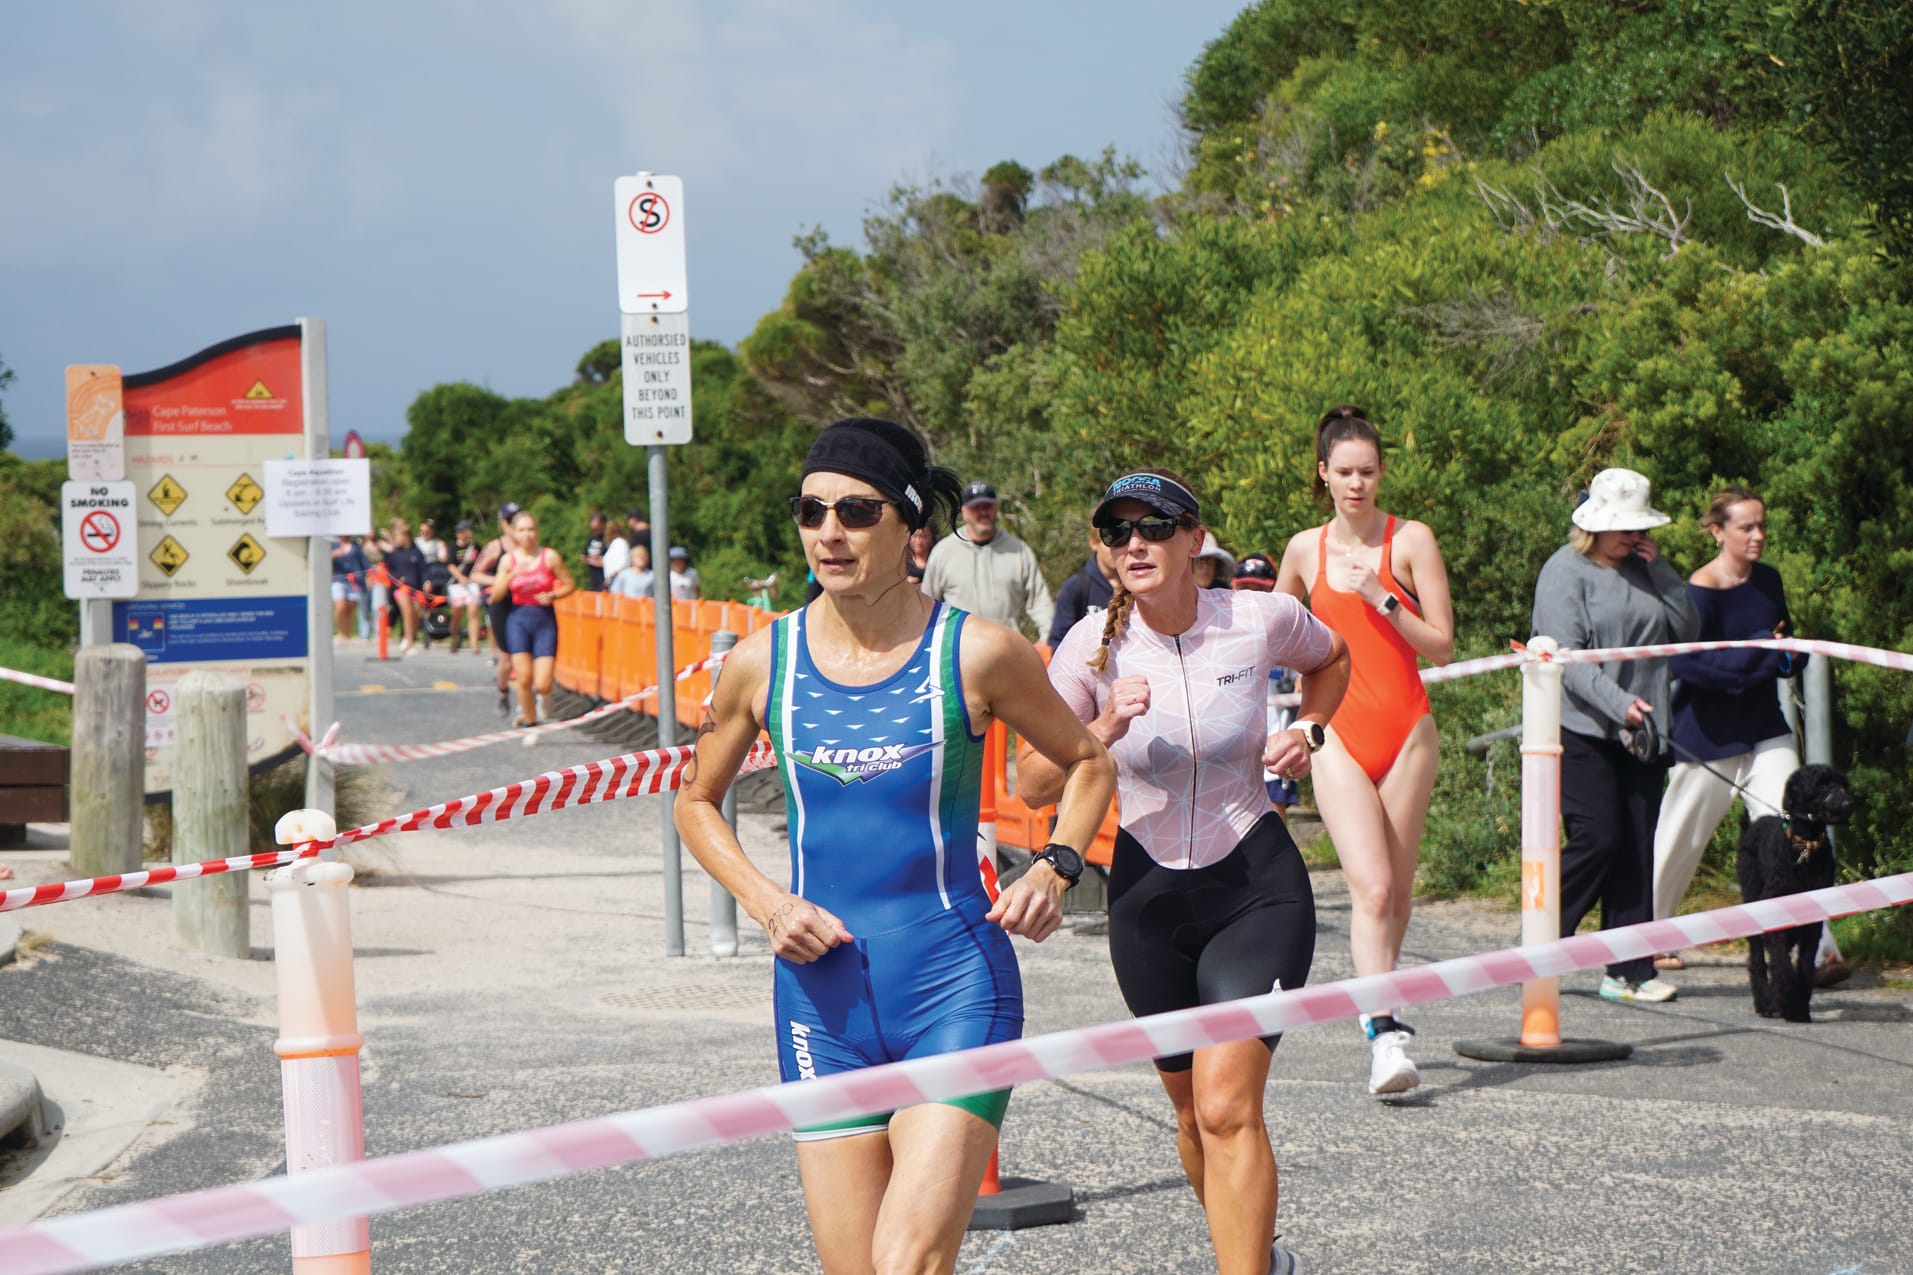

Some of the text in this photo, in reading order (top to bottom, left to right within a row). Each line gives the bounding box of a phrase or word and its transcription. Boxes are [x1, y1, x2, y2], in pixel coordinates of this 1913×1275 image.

[626, 334, 686, 347] AUTHORSIED
[633, 352, 680, 365] VEHICLES
[644, 371, 669, 383] ONLY
[638, 389, 677, 401] BEYOND
[152, 405, 179, 418] Cape
[181, 405, 226, 417] Paterson
[632, 406, 685, 419] THIS POINT
[153, 419, 232, 432] First Surf Beach
[90, 487, 108, 496] NO
[1113, 483, 1161, 497] TRIATHLON
[70, 499, 129, 508] SMOKING
[1216, 665, 1256, 687] TRI-FIT
[811, 743, 905, 764] knox
[846, 760, 902, 773] tri club
[790, 1020, 817, 1080] knox
